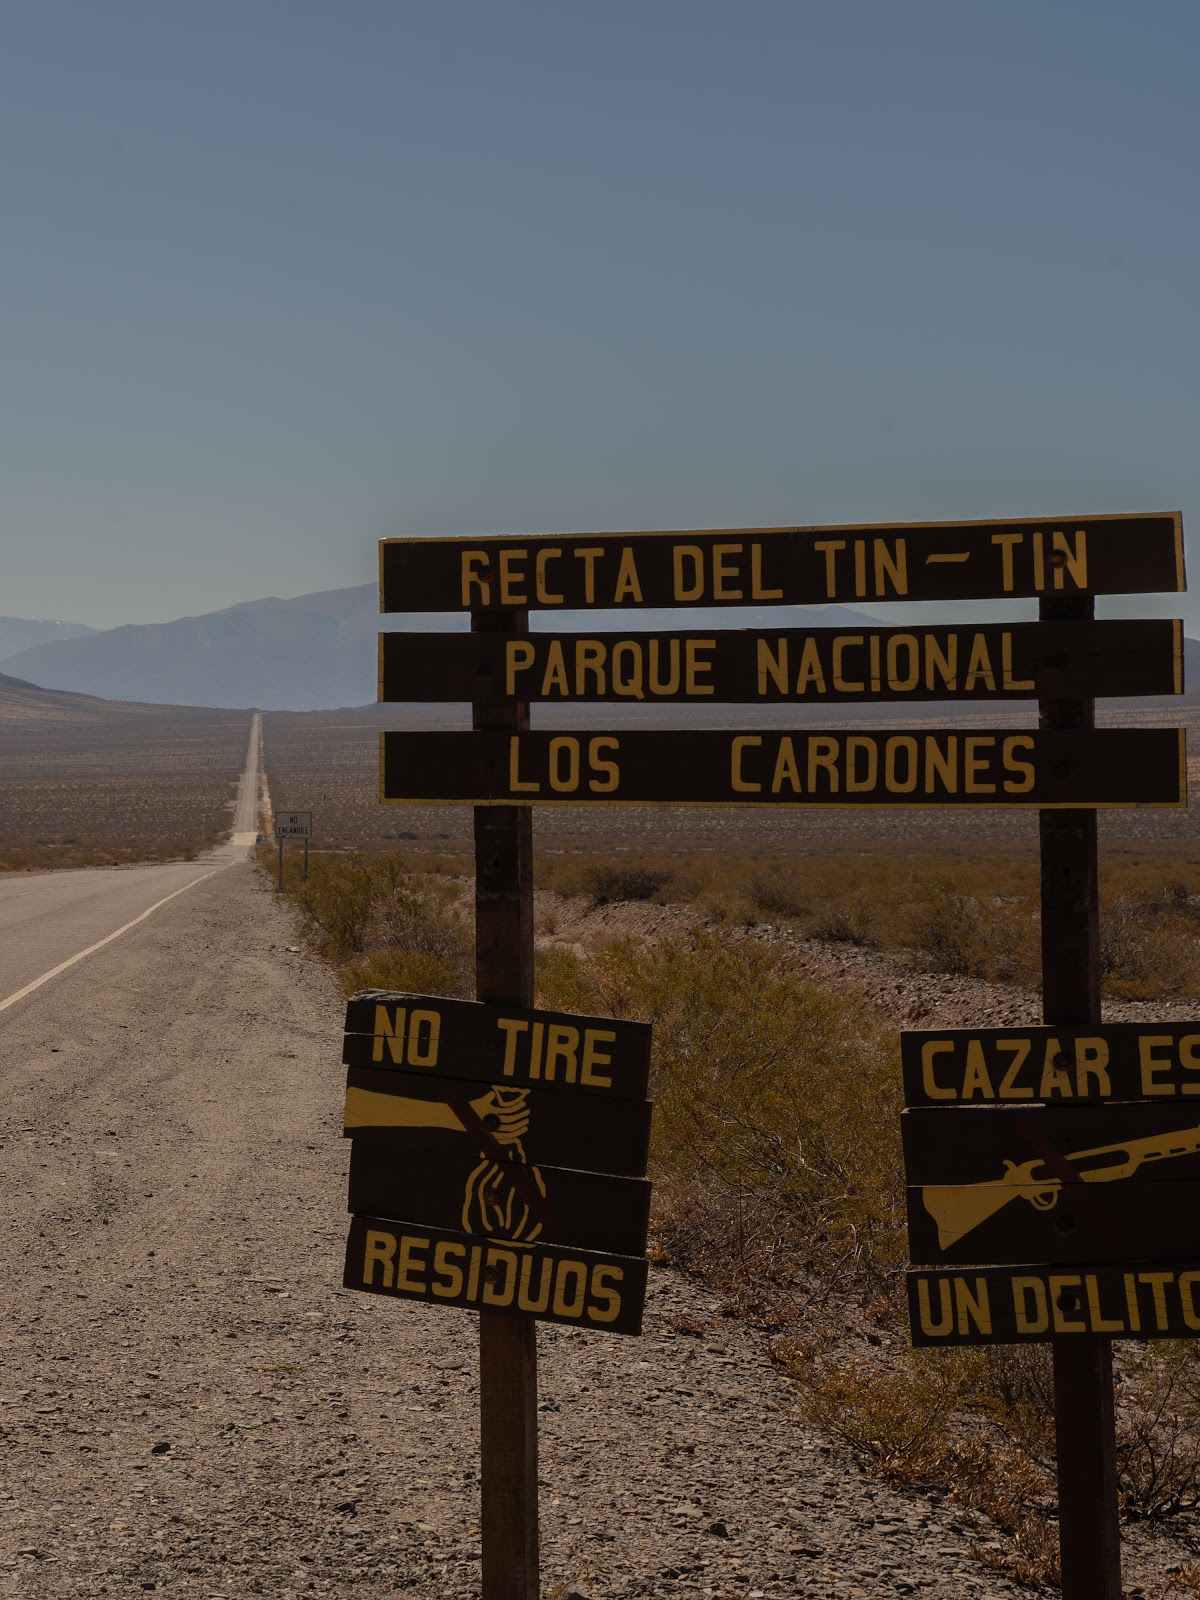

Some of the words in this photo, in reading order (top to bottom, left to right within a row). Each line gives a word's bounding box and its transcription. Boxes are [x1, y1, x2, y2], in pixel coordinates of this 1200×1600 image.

[461, 549, 643, 606] RECTA
[673, 544, 784, 601] DEL
[814, 539, 908, 598] TIN
[991, 531, 1088, 591] TIN
[505, 639, 716, 699] PARQUE
[757, 633, 1036, 695] NACIONAL
[509, 736, 620, 793] LOS
[731, 736, 1036, 794] CARDONES
[278, 827, 309, 835] ENCANDILE
[290, 816, 298, 824] NO
[372, 1004, 441, 1067] NO
[497, 1018, 616, 1088] TIRE
[921, 1037, 1112, 1100] CAZAR
[362, 1229, 624, 1323] RESIDUOS
[917, 1277, 993, 1337] UN
[1011, 1271, 1200, 1334] DELITO
